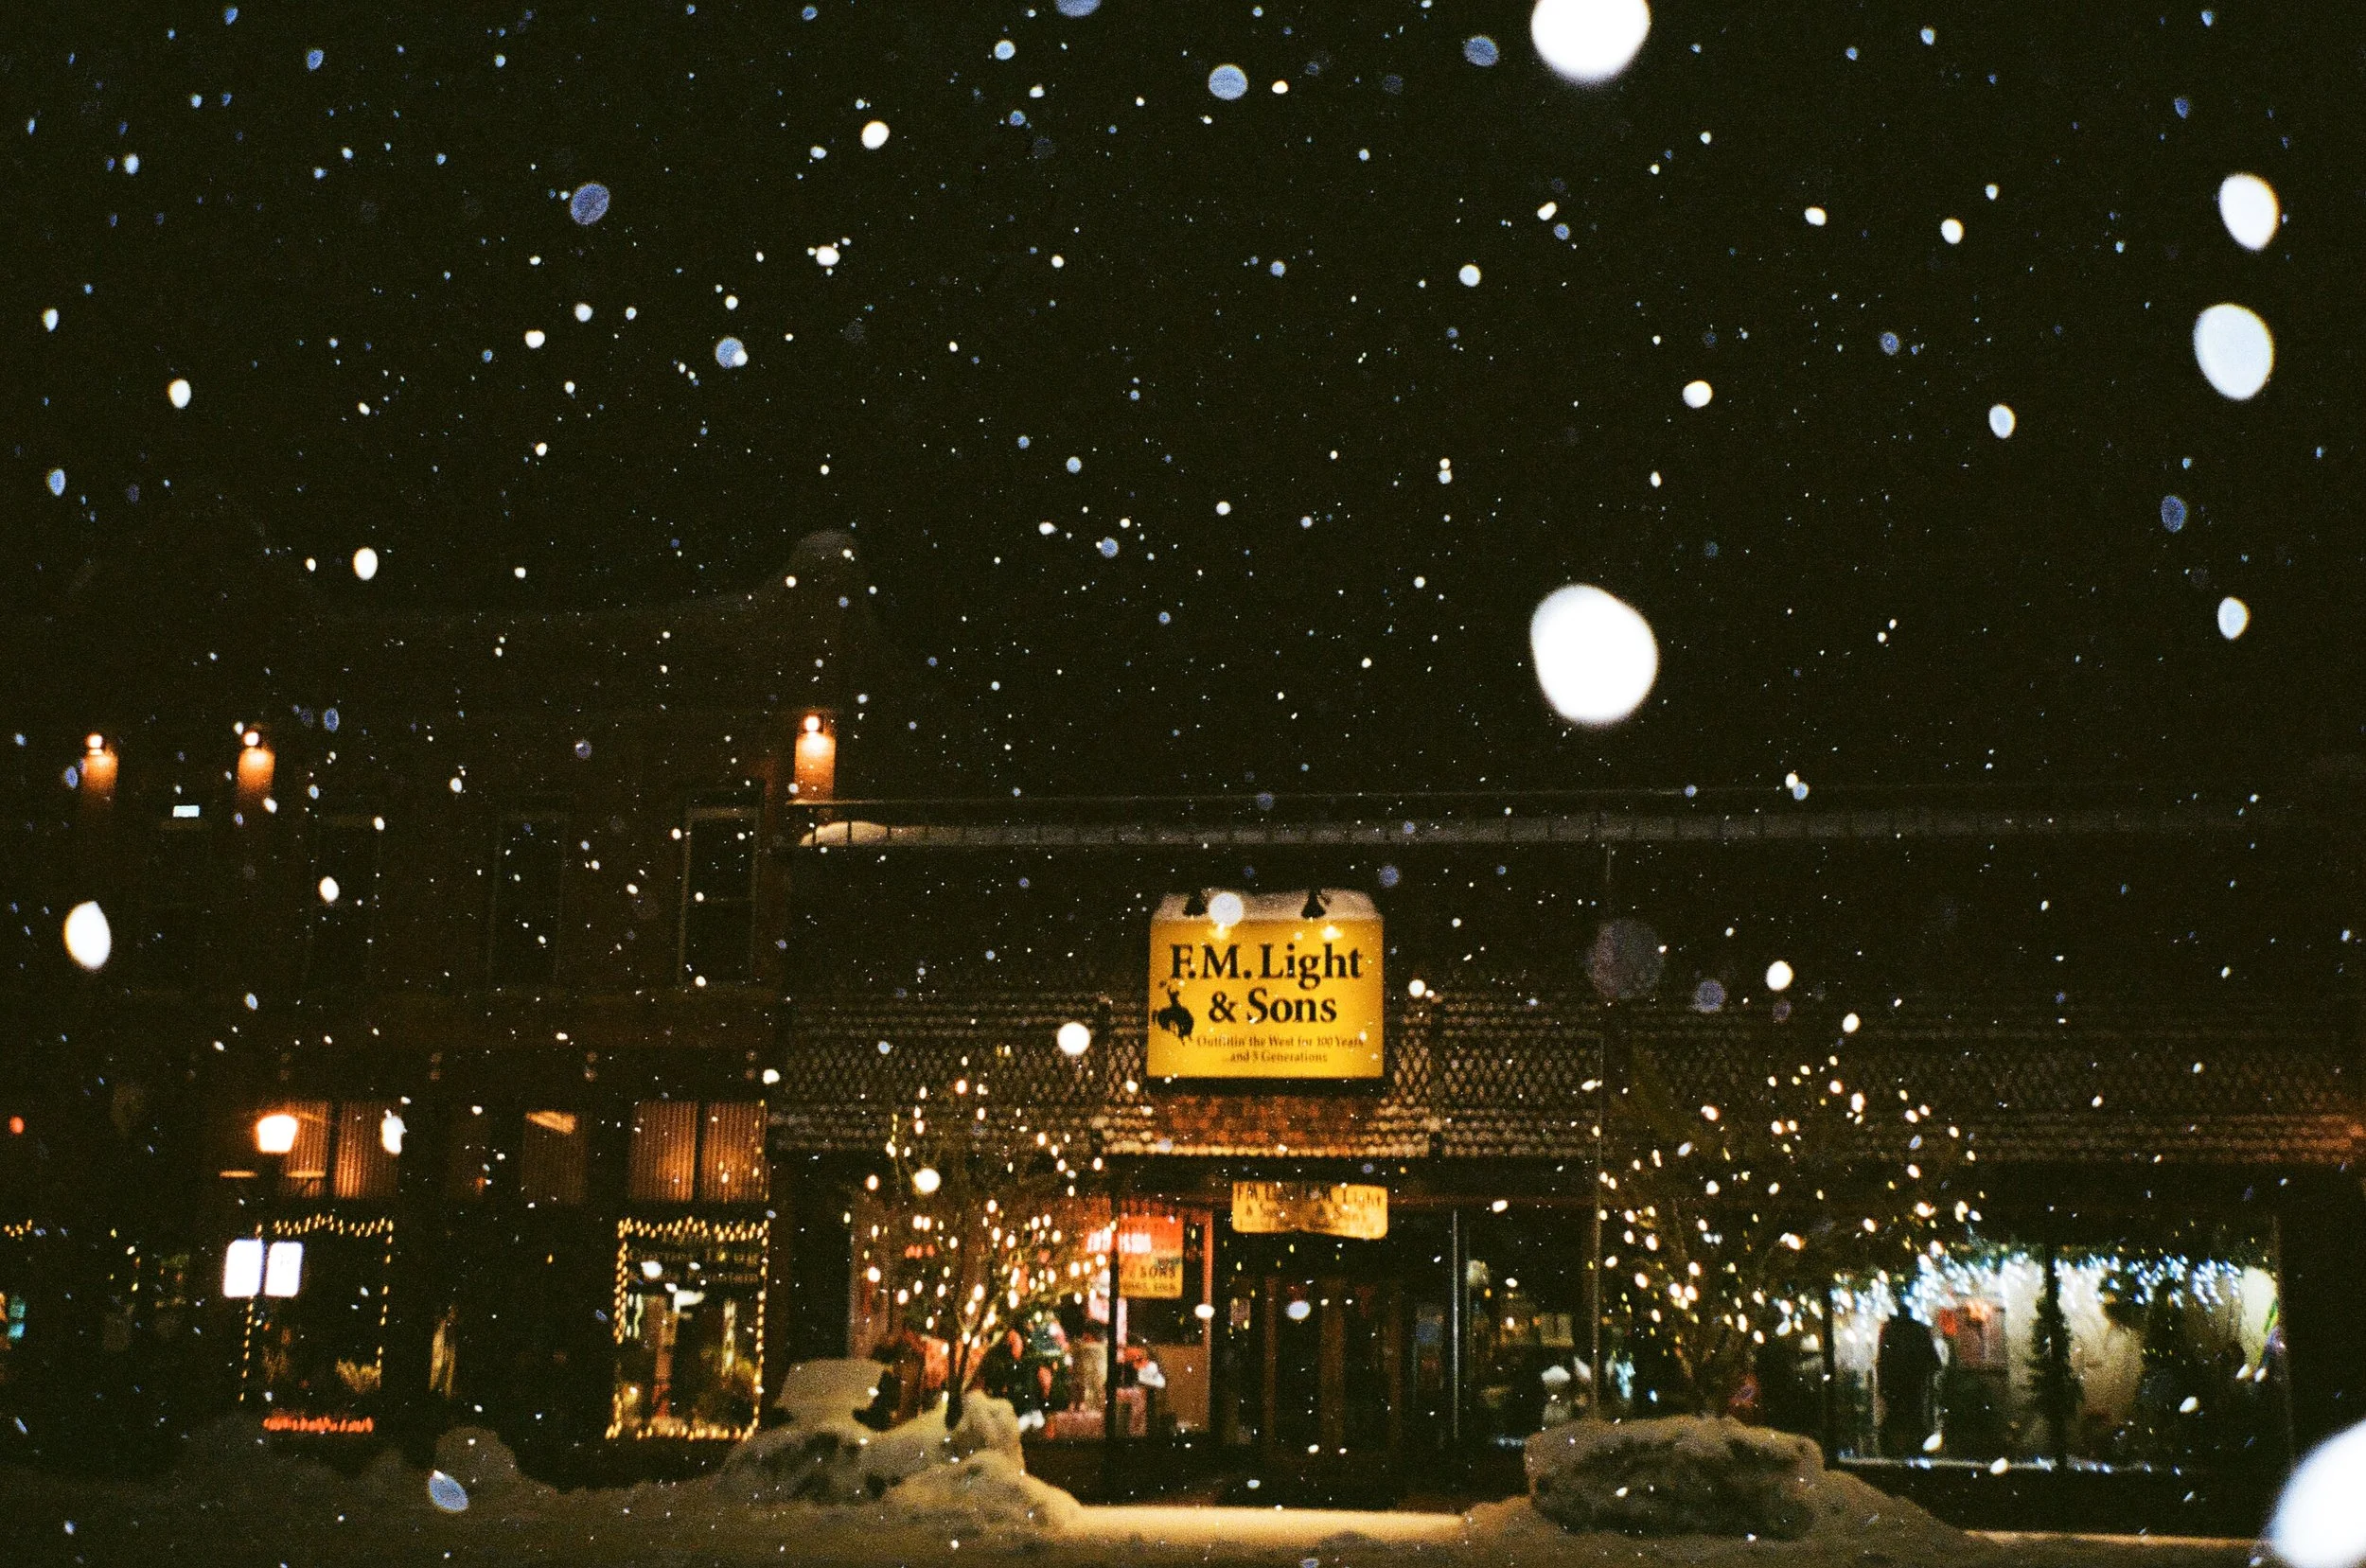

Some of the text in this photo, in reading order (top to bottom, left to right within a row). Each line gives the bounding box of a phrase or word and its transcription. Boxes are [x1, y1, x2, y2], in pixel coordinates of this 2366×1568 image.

[1259, 943, 1365, 991] Light
[1208, 986, 1337, 1024] & Sons
[1249, 1034, 1265, 1047] the
[1268, 1034, 1294, 1047] West
[1261, 1049, 1328, 1062] Generations
